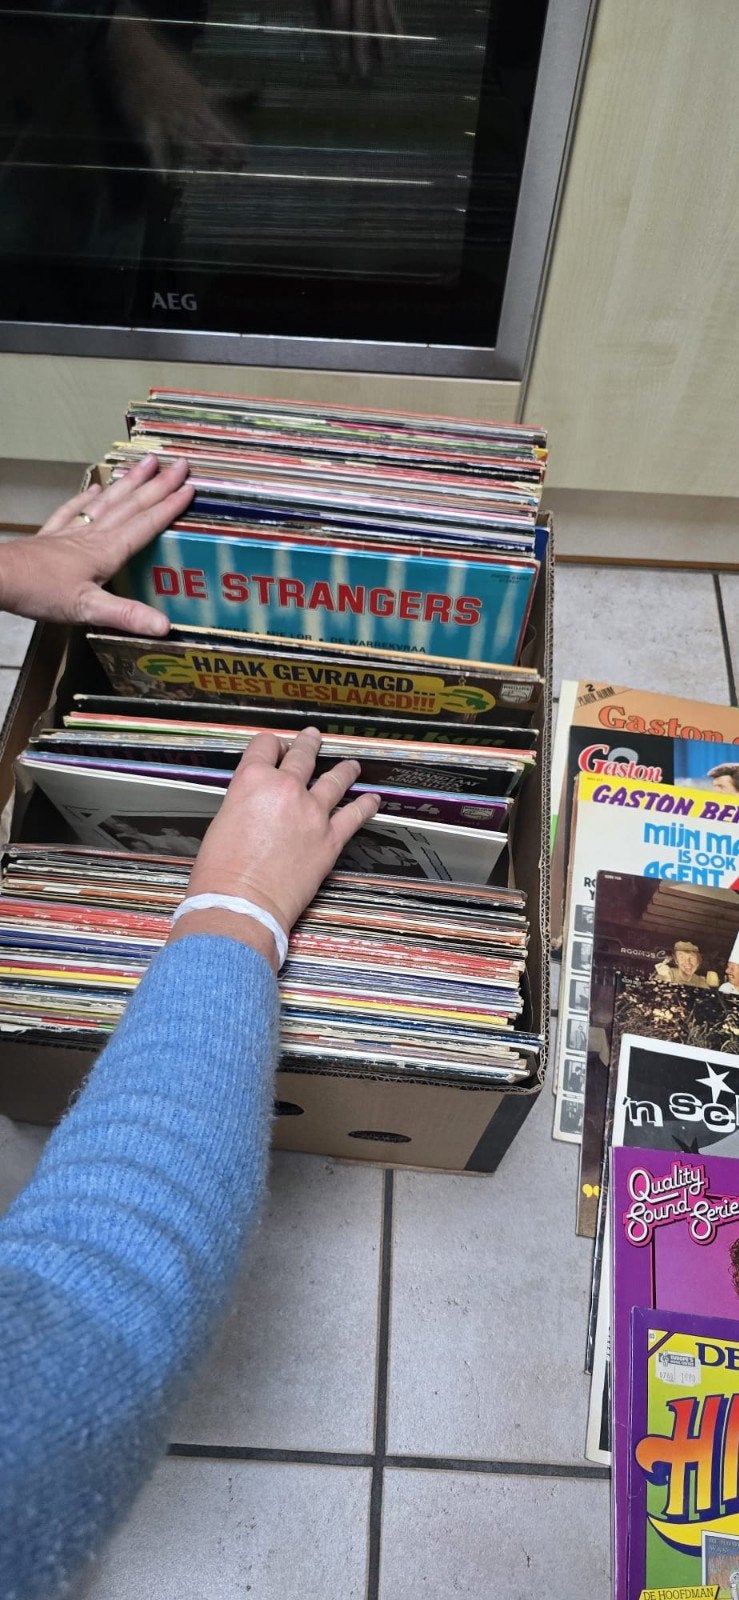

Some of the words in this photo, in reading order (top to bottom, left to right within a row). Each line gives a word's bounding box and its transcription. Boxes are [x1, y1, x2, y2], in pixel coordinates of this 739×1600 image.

[152, 291, 198, 311] AEG
[151, 566, 207, 600] DE
[221, 570, 484, 627] STRANGERS
[192, 656, 269, 680] HAAK
[199, 675, 275, 697] FEEST
[282, 682, 437, 714] GESLAAGD!!!
[585, 683, 596, 693] 2
[598, 704, 724, 743] Gaston
[578, 743, 664, 783] Gaston
[592, 784, 695, 817] GASTON
[643, 861, 725, 888] AGENT
[678, 849, 691, 864] IS
[695, 853, 736, 871] OOK
[629, 1164, 705, 1204] Quality
[626, 1189, 690, 1242] Sound
[643, 1590, 657, 1600] DE
[657, 1587, 714, 1600] HOOFDMAN
